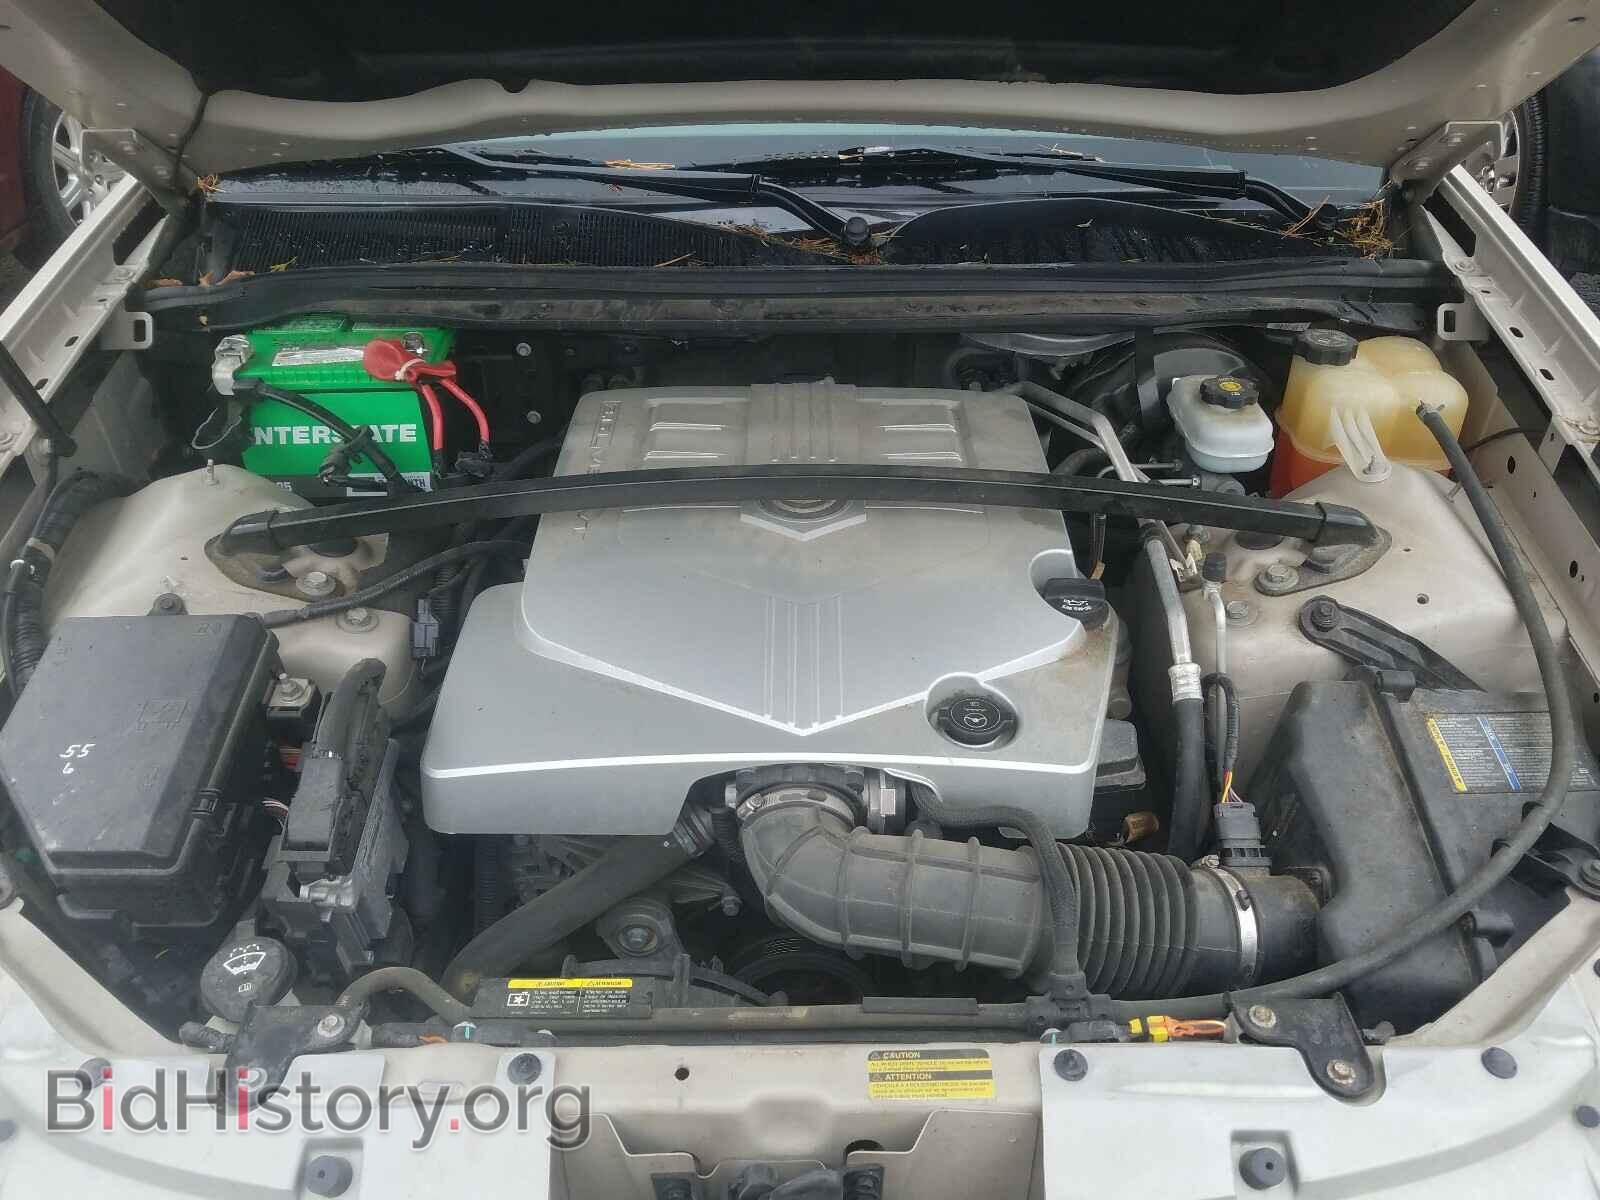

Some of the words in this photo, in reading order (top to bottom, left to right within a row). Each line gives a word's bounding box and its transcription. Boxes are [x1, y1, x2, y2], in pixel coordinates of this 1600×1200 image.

[252, 424, 417, 446] NTERSATE
[882, 1051, 921, 1060] CAUTION
[884, 1072, 932, 1082] ATTENTION
